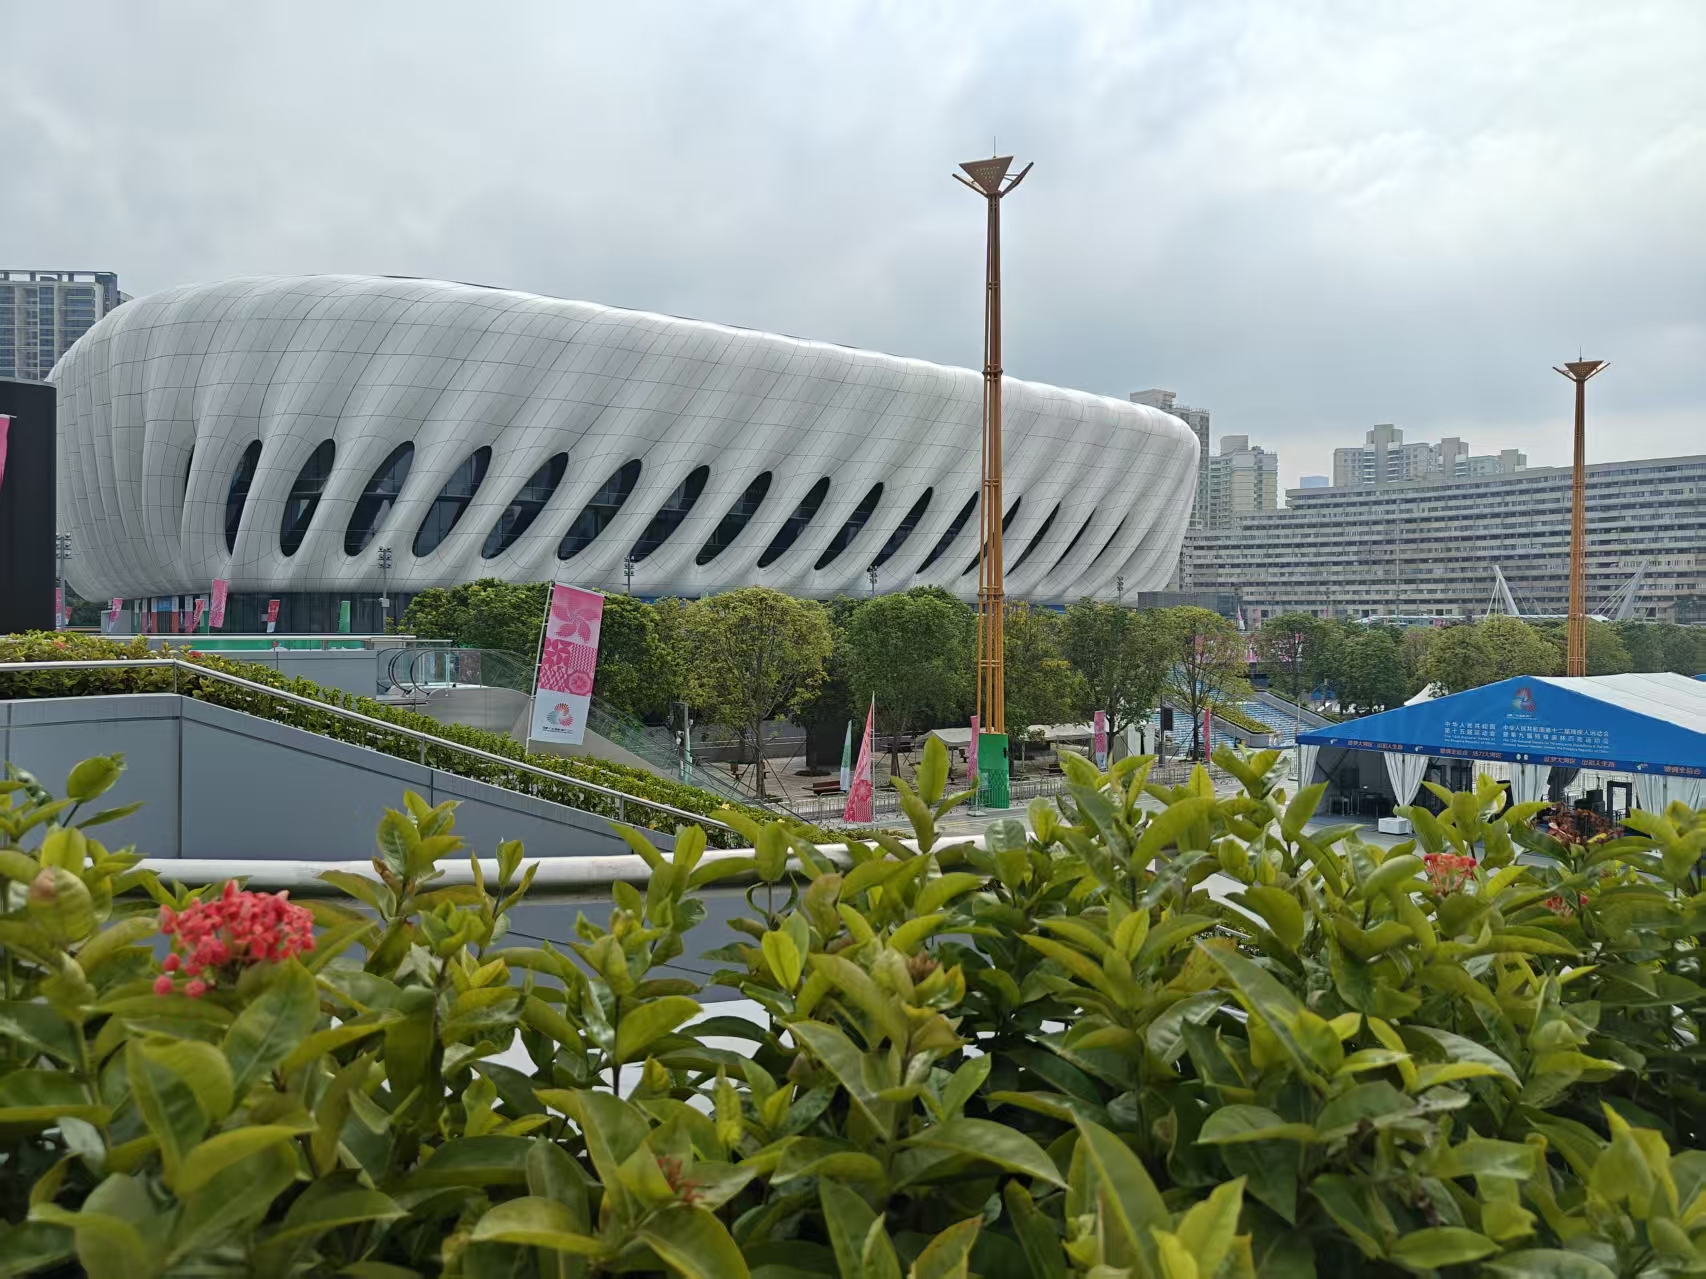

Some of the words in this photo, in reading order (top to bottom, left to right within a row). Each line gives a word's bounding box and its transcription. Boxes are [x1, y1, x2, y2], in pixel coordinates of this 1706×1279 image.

[1444, 721, 1496, 730] 中华人民共和国
